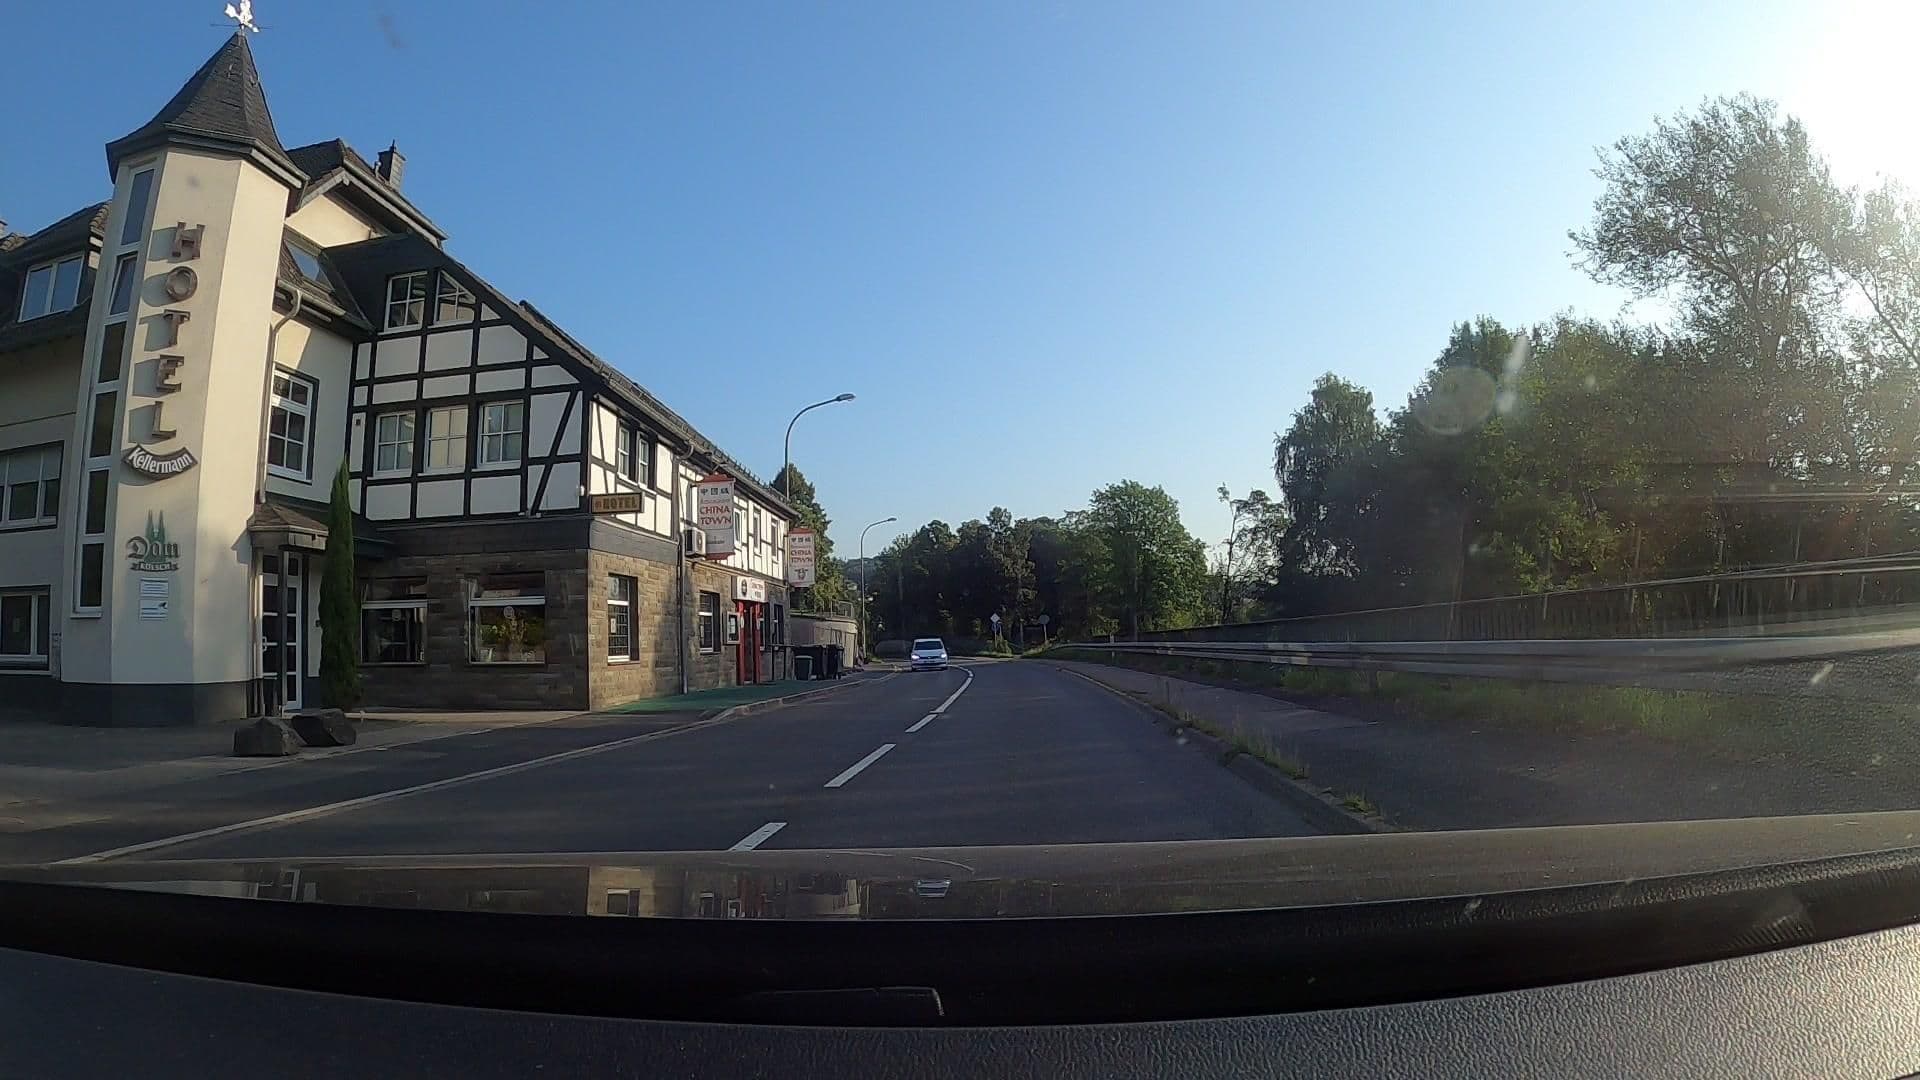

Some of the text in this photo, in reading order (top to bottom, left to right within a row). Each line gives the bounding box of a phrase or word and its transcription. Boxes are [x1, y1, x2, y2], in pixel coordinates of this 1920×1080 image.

[152, 221, 206, 440] HOTEL
[128, 447, 193, 474] Kellermann
[603, 496, 638, 510] HOTEL
[699, 505, 731, 515] CHINA
[700, 516, 732, 525] TOWN
[126, 536, 179, 559] Dom
